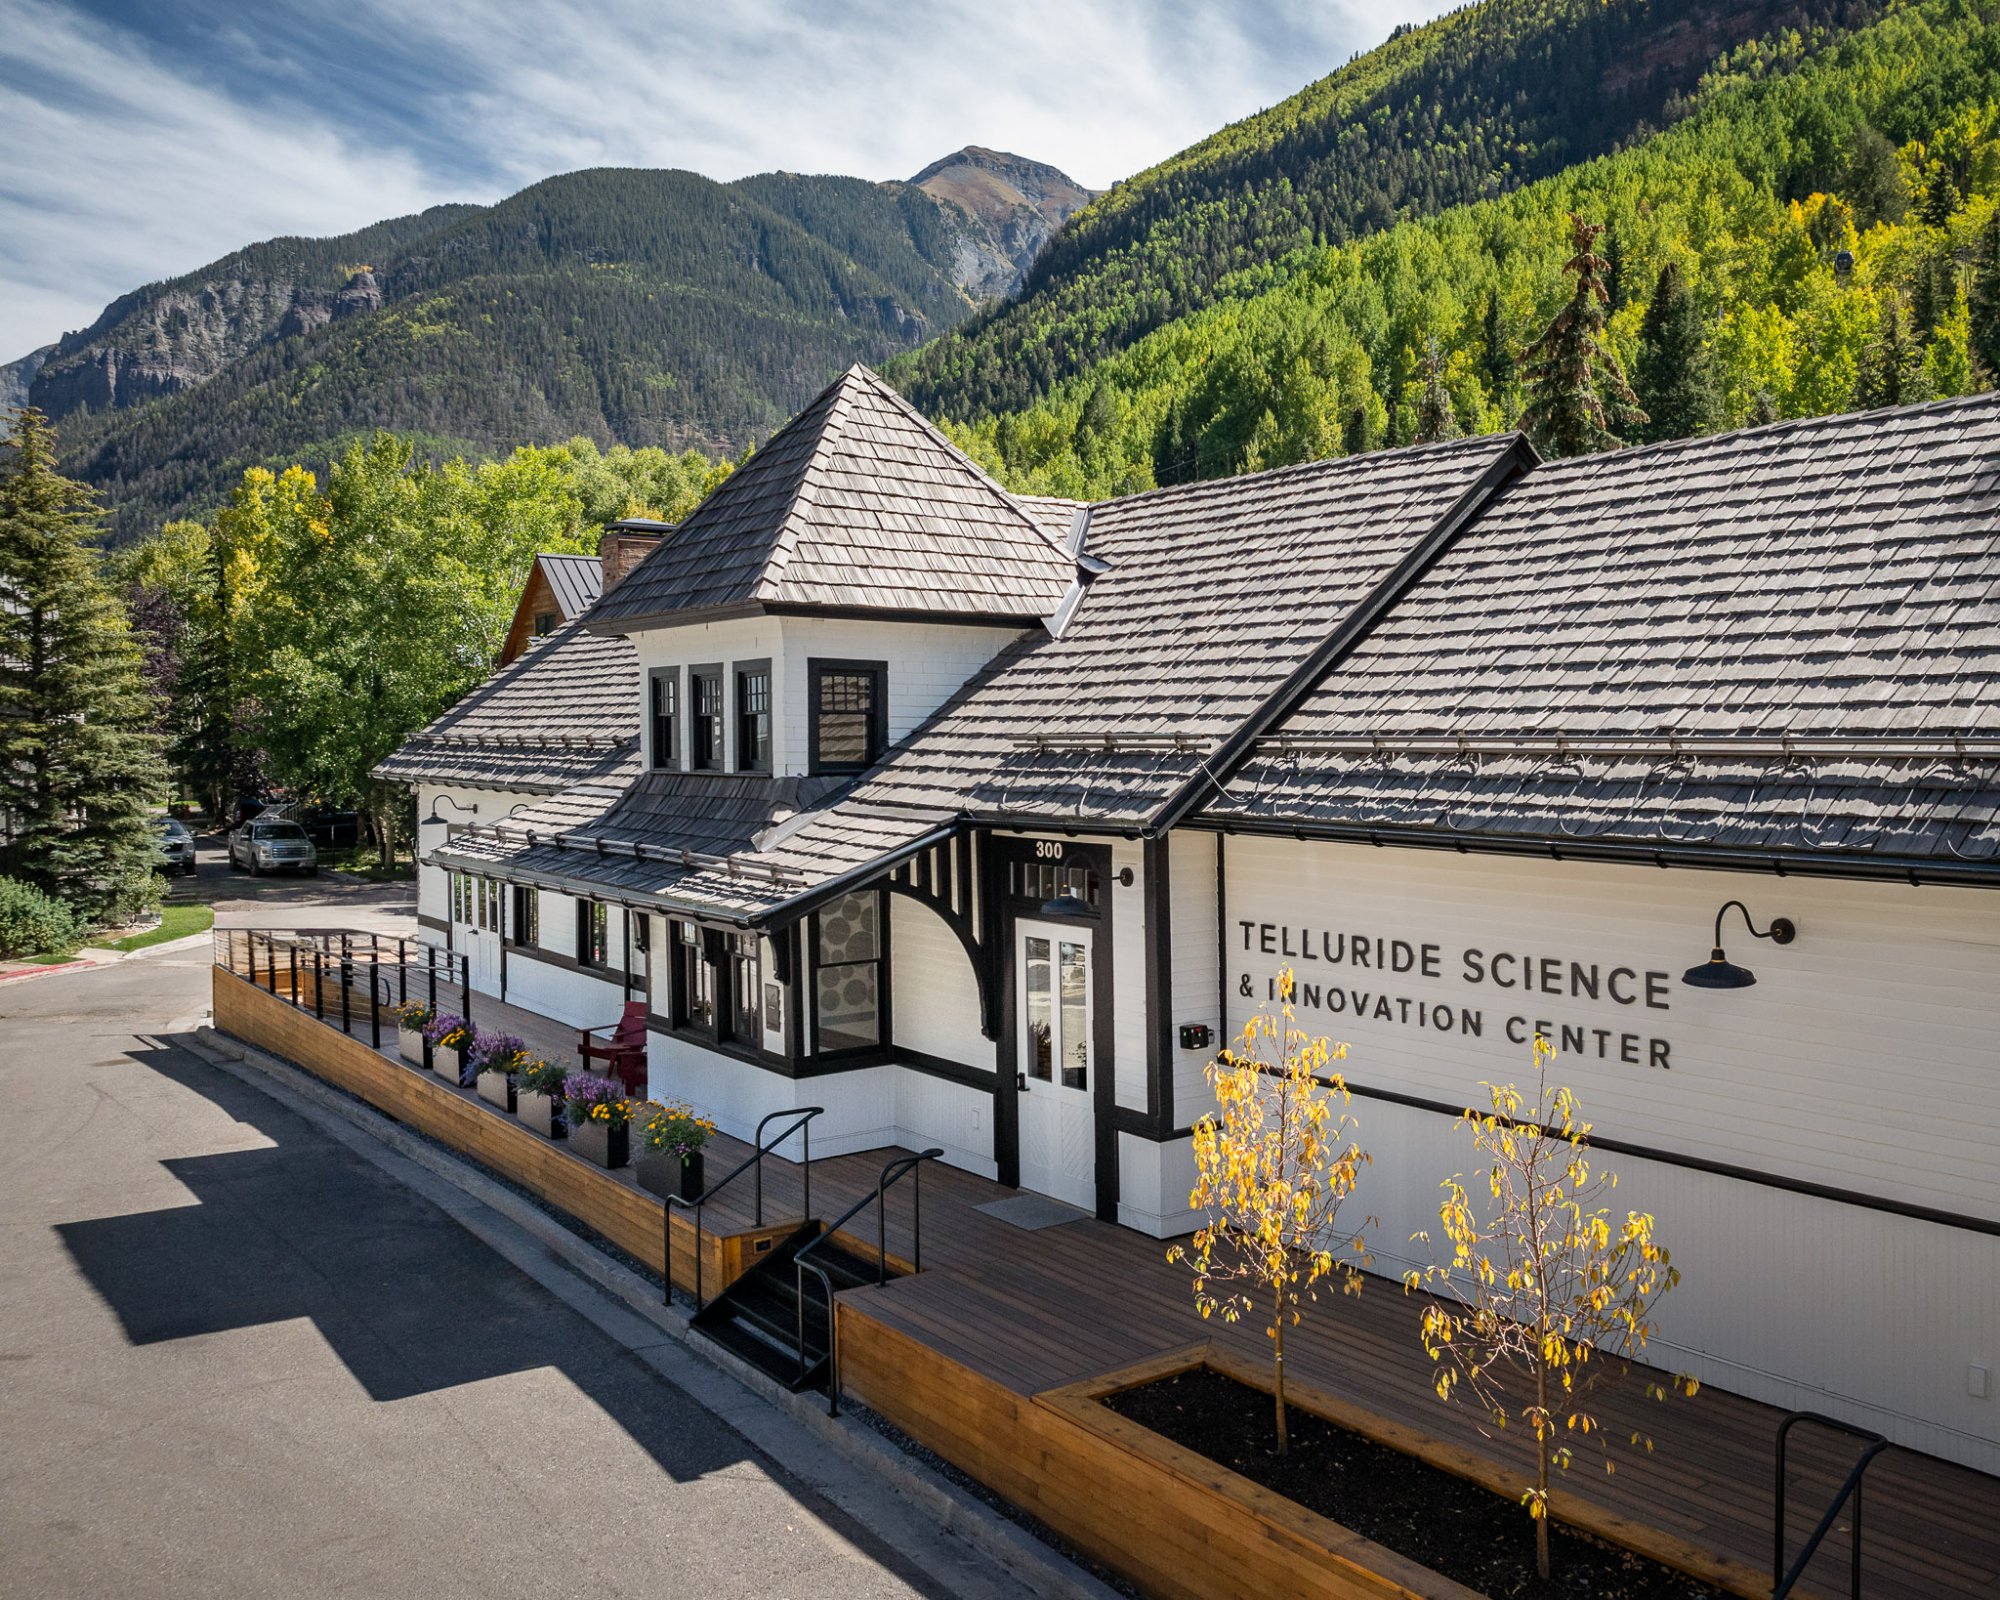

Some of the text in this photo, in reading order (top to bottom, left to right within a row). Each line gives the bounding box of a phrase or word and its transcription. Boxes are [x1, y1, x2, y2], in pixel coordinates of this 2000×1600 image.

[1036, 841, 1063, 859] 300
[1238, 920, 1670, 1010] TELLURIDE SCIENCE
[1239, 973, 1671, 1070] & INNOVATION CENTER
